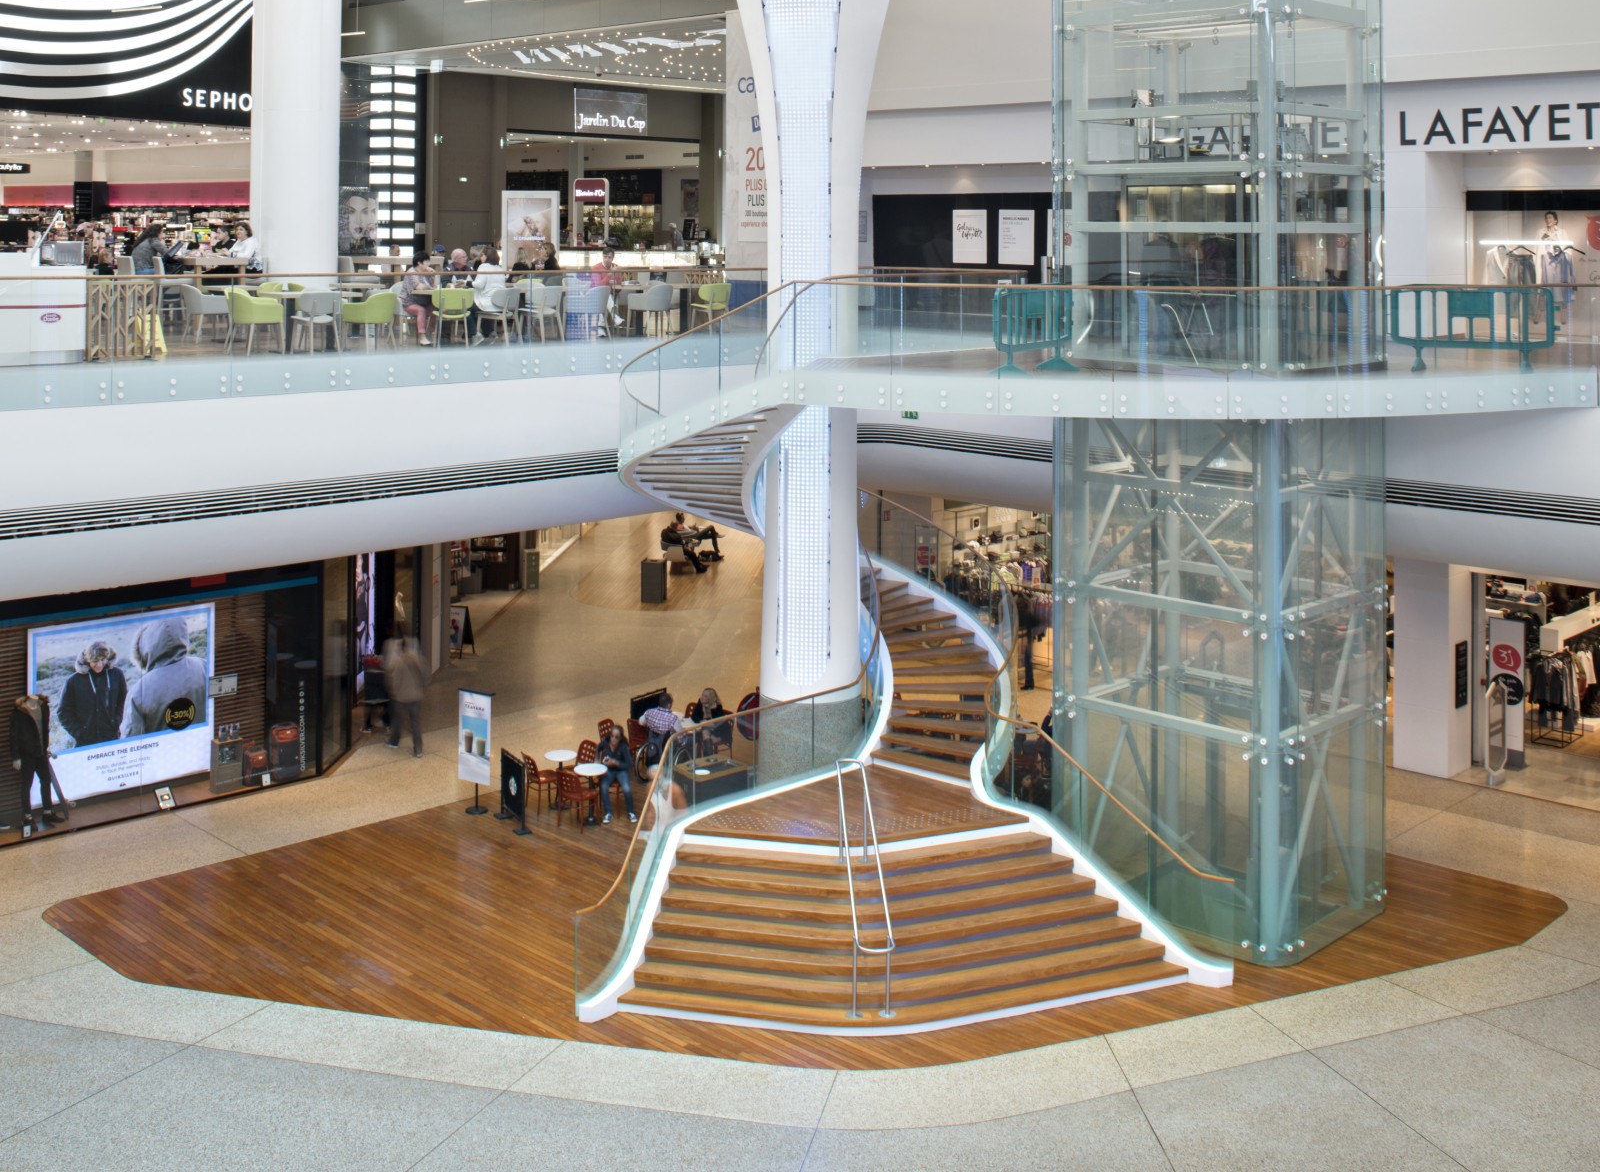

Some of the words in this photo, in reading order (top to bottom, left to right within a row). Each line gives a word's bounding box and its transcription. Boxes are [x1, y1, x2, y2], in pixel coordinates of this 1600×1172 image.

[737, 76, 756, 99] ca
[182, 87, 253, 112] SEPHO
[577, 112, 610, 130] Jardin
[610, 115, 626, 128] Du
[627, 115, 646, 132] Cap
[1399, 102, 1600, 146] LAFAYET
[745, 178, 763, 191] PLUS
[747, 194, 765, 207] PLUS
[87, 750, 115, 761] EMBRACE
[117, 747, 128, 755] THE
[130, 741, 160, 752] ELEMENTS
